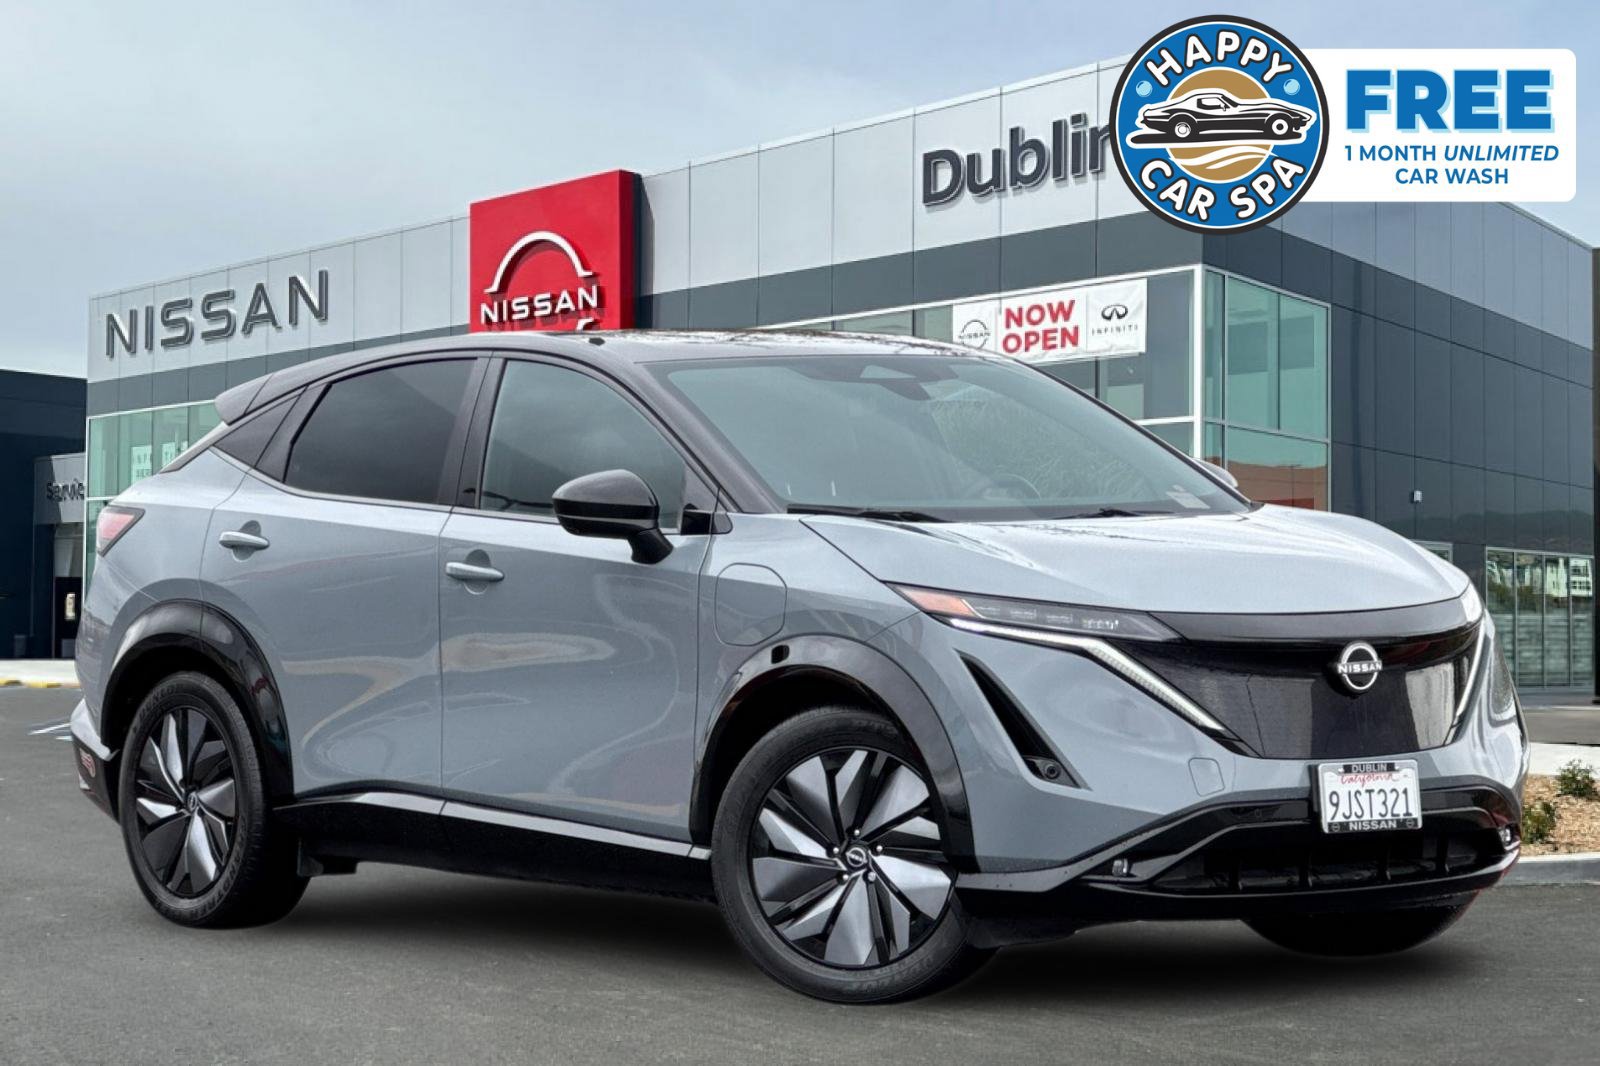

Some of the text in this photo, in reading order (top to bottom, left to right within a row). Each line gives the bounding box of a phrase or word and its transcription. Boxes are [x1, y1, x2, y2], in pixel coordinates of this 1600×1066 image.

[105, 269, 329, 359] NISSAN
[480, 285, 599, 325] NISSAN
[1005, 299, 1076, 330] NOW
[1002, 325, 1080, 354] OPEN
[46, 478, 85, 502] Servic
[1337, 662, 1383, 674] NISSAN
[1340, 773, 1397, 787] California
[1351, 763, 1388, 773] DUBLIN
[1328, 787, 1413, 821] 9JST321
[1349, 819, 1397, 831] NISSAN
